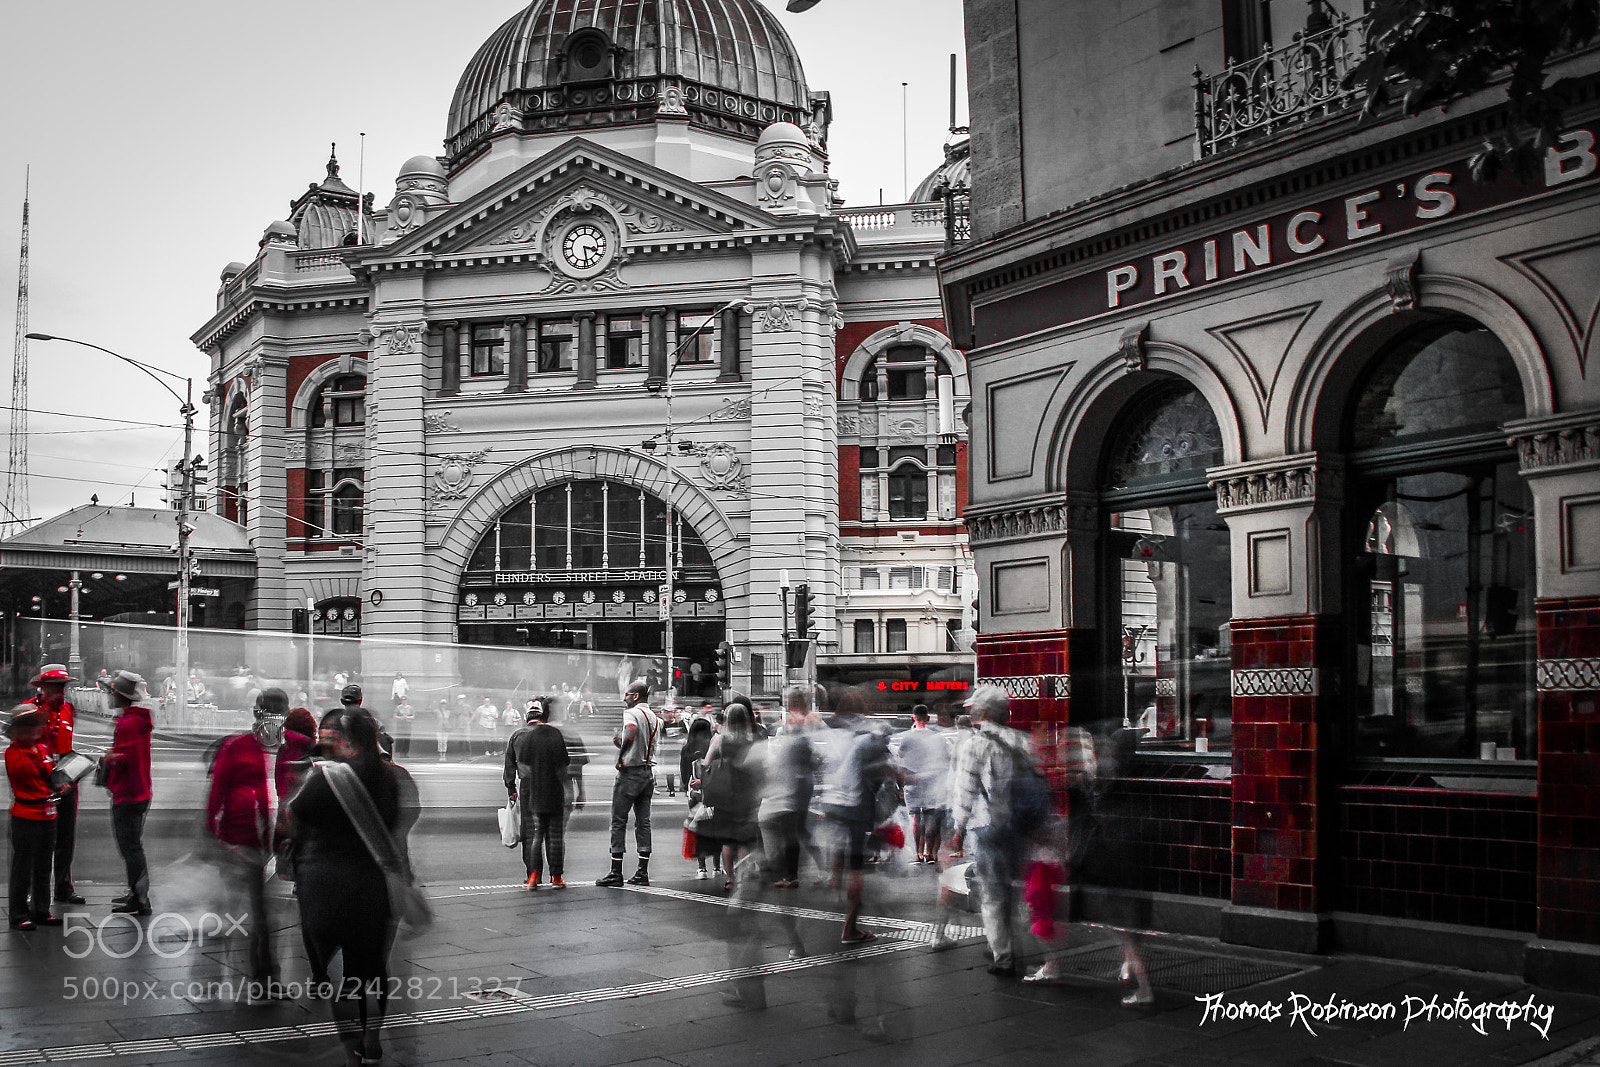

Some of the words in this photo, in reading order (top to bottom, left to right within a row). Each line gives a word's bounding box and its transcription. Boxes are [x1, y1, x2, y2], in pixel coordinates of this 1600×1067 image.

[1106, 171, 1458, 308] PRINCE'S
[494, 572, 552, 584] FLINDERS
[565, 571, 610, 583] STREET
[623, 569, 681, 582] STATION
[891, 681, 919, 691] CITY
